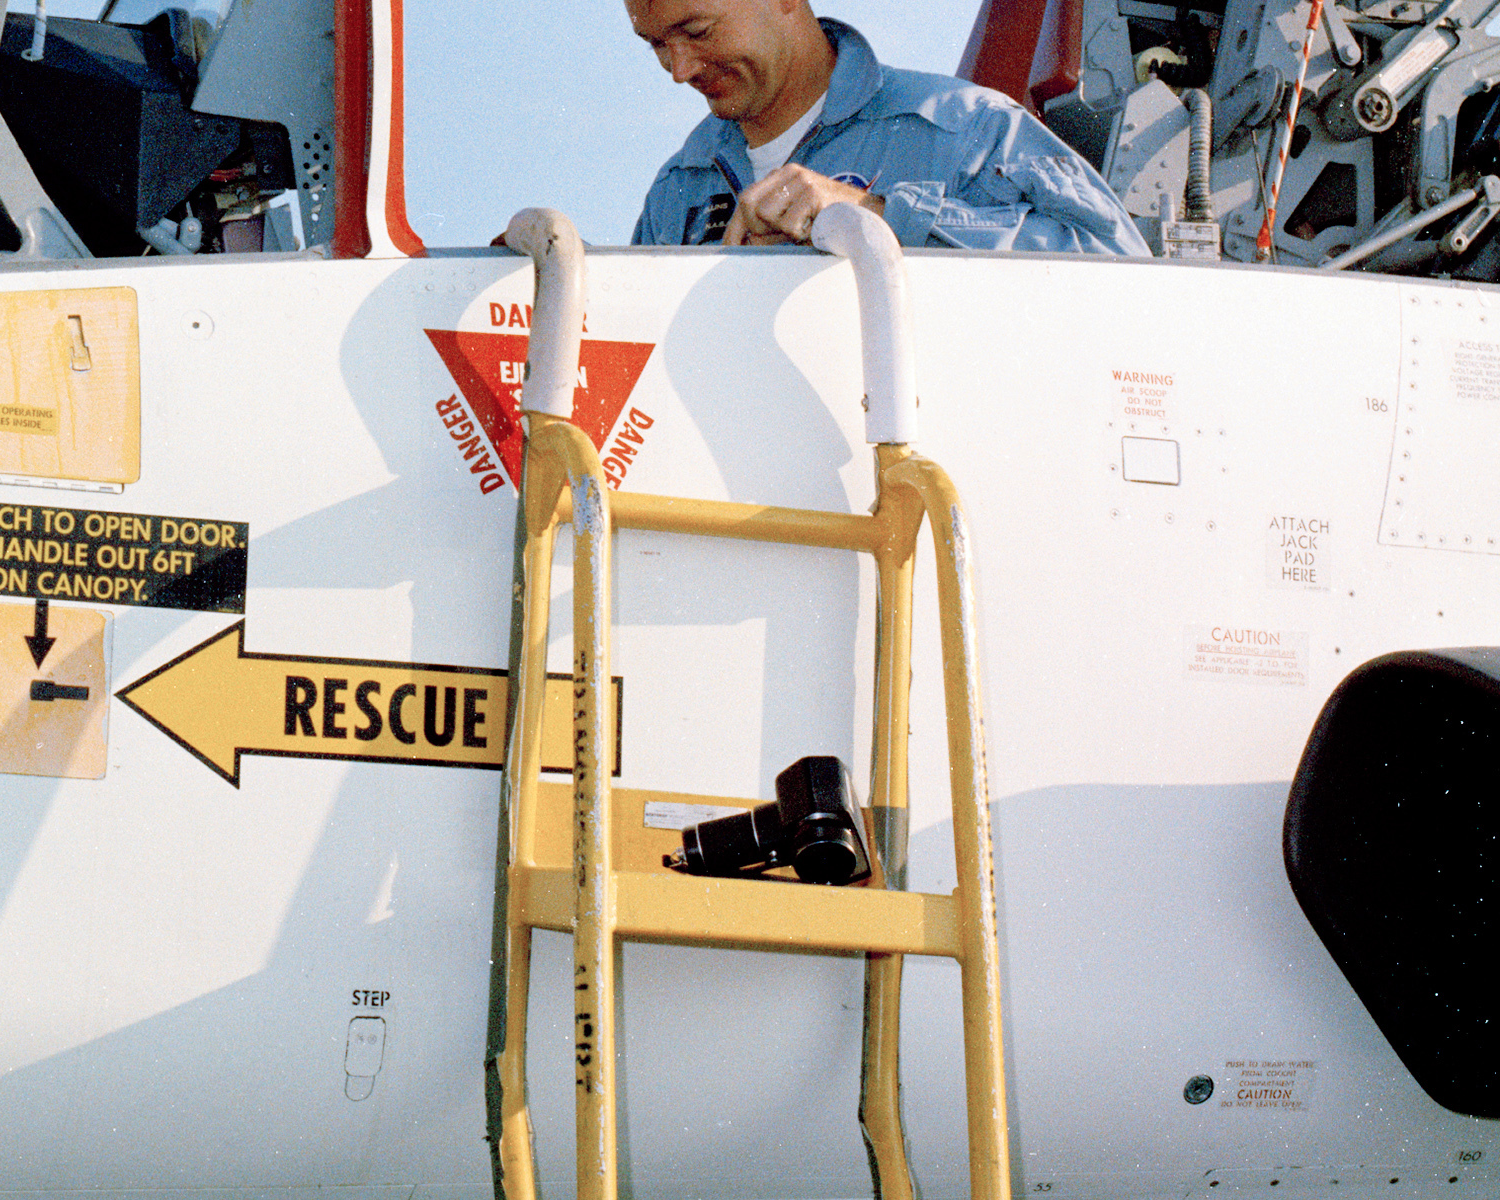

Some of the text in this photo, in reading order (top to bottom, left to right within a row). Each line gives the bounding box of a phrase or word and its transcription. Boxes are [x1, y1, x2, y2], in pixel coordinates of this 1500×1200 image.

[1112, 370, 1173, 385] WARNING
[1121, 386, 1167, 397] AIR SCOOP
[2, 406, 53, 418] OPERATING
[1124, 406, 1165, 417] OBSTRUCT
[1366, 397, 1388, 412] 186
[13, 419, 41, 429] INSIDE
[435, 393, 506, 495] DANGER
[602, 406, 655, 491] DANGE
[42, 509, 75, 535] TO
[84, 513, 151, 542] OPEN
[160, 519, 246, 549] DOOR.
[1270, 517, 1329, 534] ATTACH
[1280, 534, 1318, 550] JACK
[96, 544, 149, 571] OUT
[153, 550, 195, 576] 6FT
[1285, 550, 1315, 565] PAD
[1282, 567, 1316, 583] HERE
[37, 569, 148, 601] CANOPY.
[1211, 627, 1280, 645] CAUTION
[284, 675, 489, 748] RESCUE
[352, 990, 390, 1006] STEP
[1237, 1089, 1292, 1099] CAUTION
